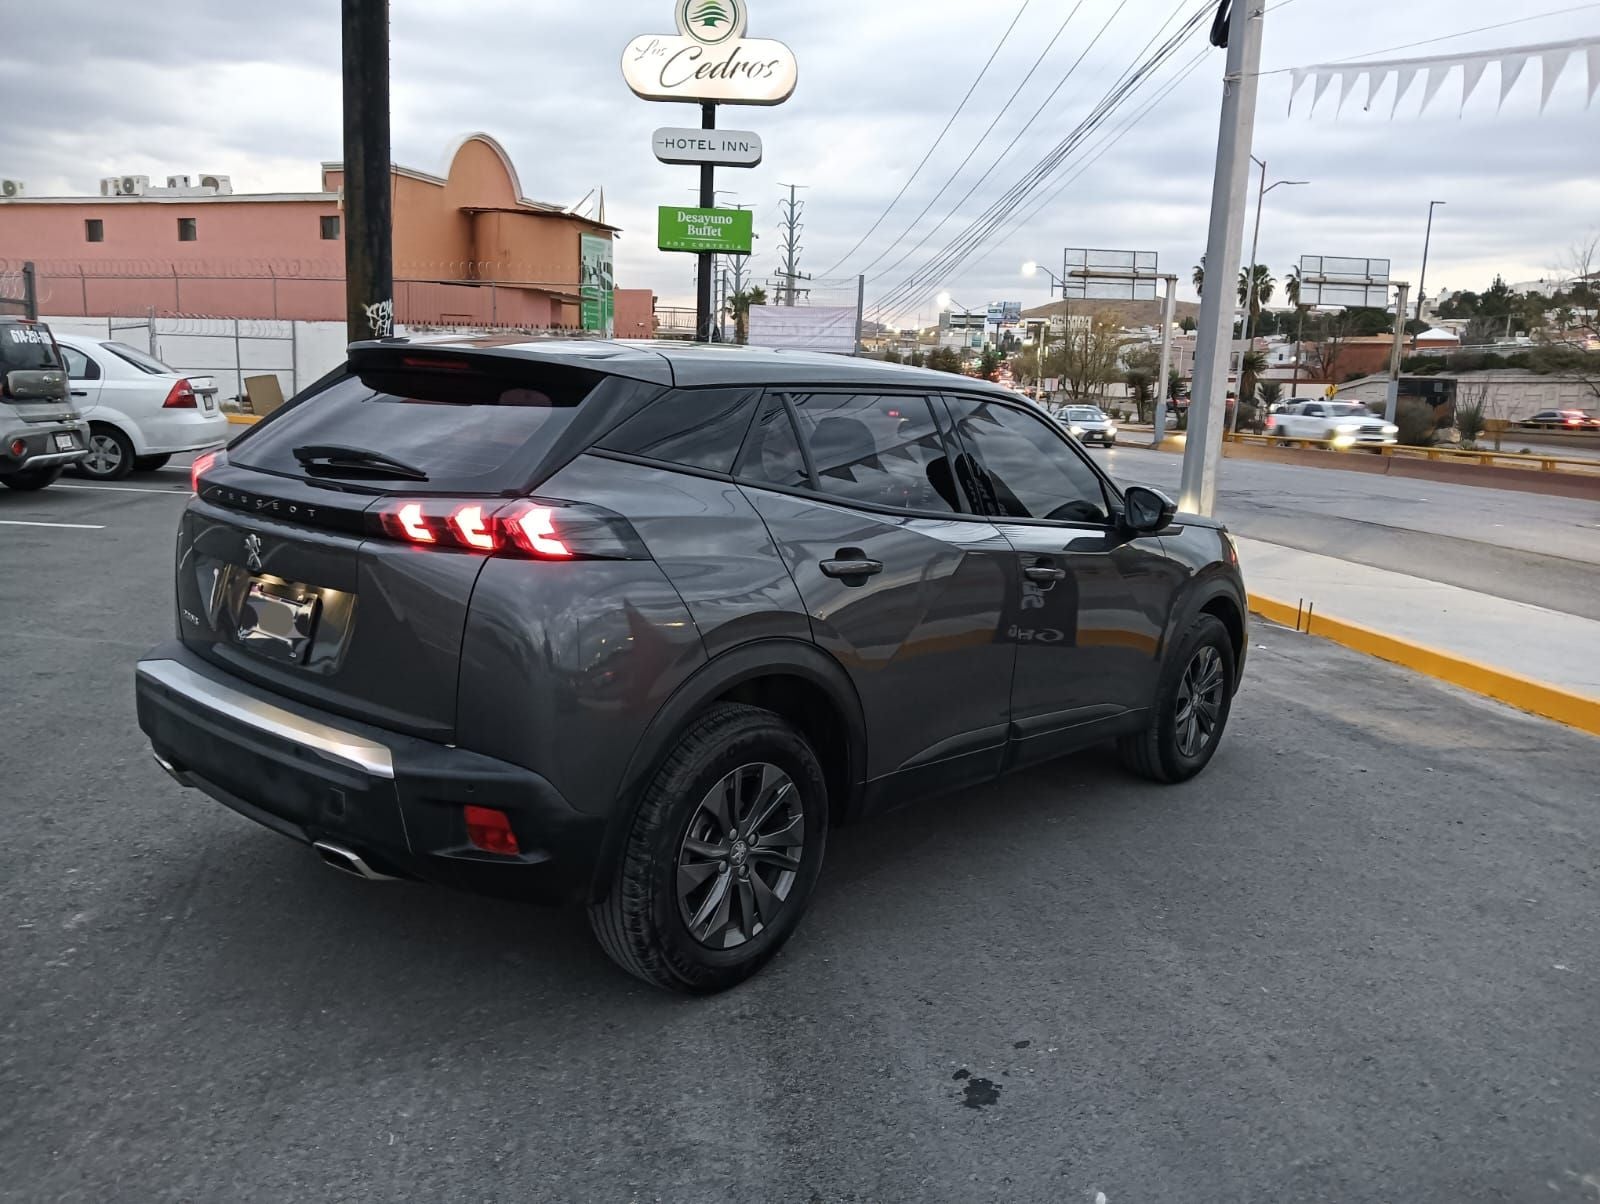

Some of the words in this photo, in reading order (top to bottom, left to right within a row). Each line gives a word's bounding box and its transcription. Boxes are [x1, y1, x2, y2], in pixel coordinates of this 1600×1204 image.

[634, 39, 667, 61] Los
[659, 45, 779, 88] Cedros
[665, 138, 716, 151] HOTEL
[722, 141, 749, 152] INN
[677, 210, 733, 226] Desayuno
[687, 224, 722, 237] Buffet
